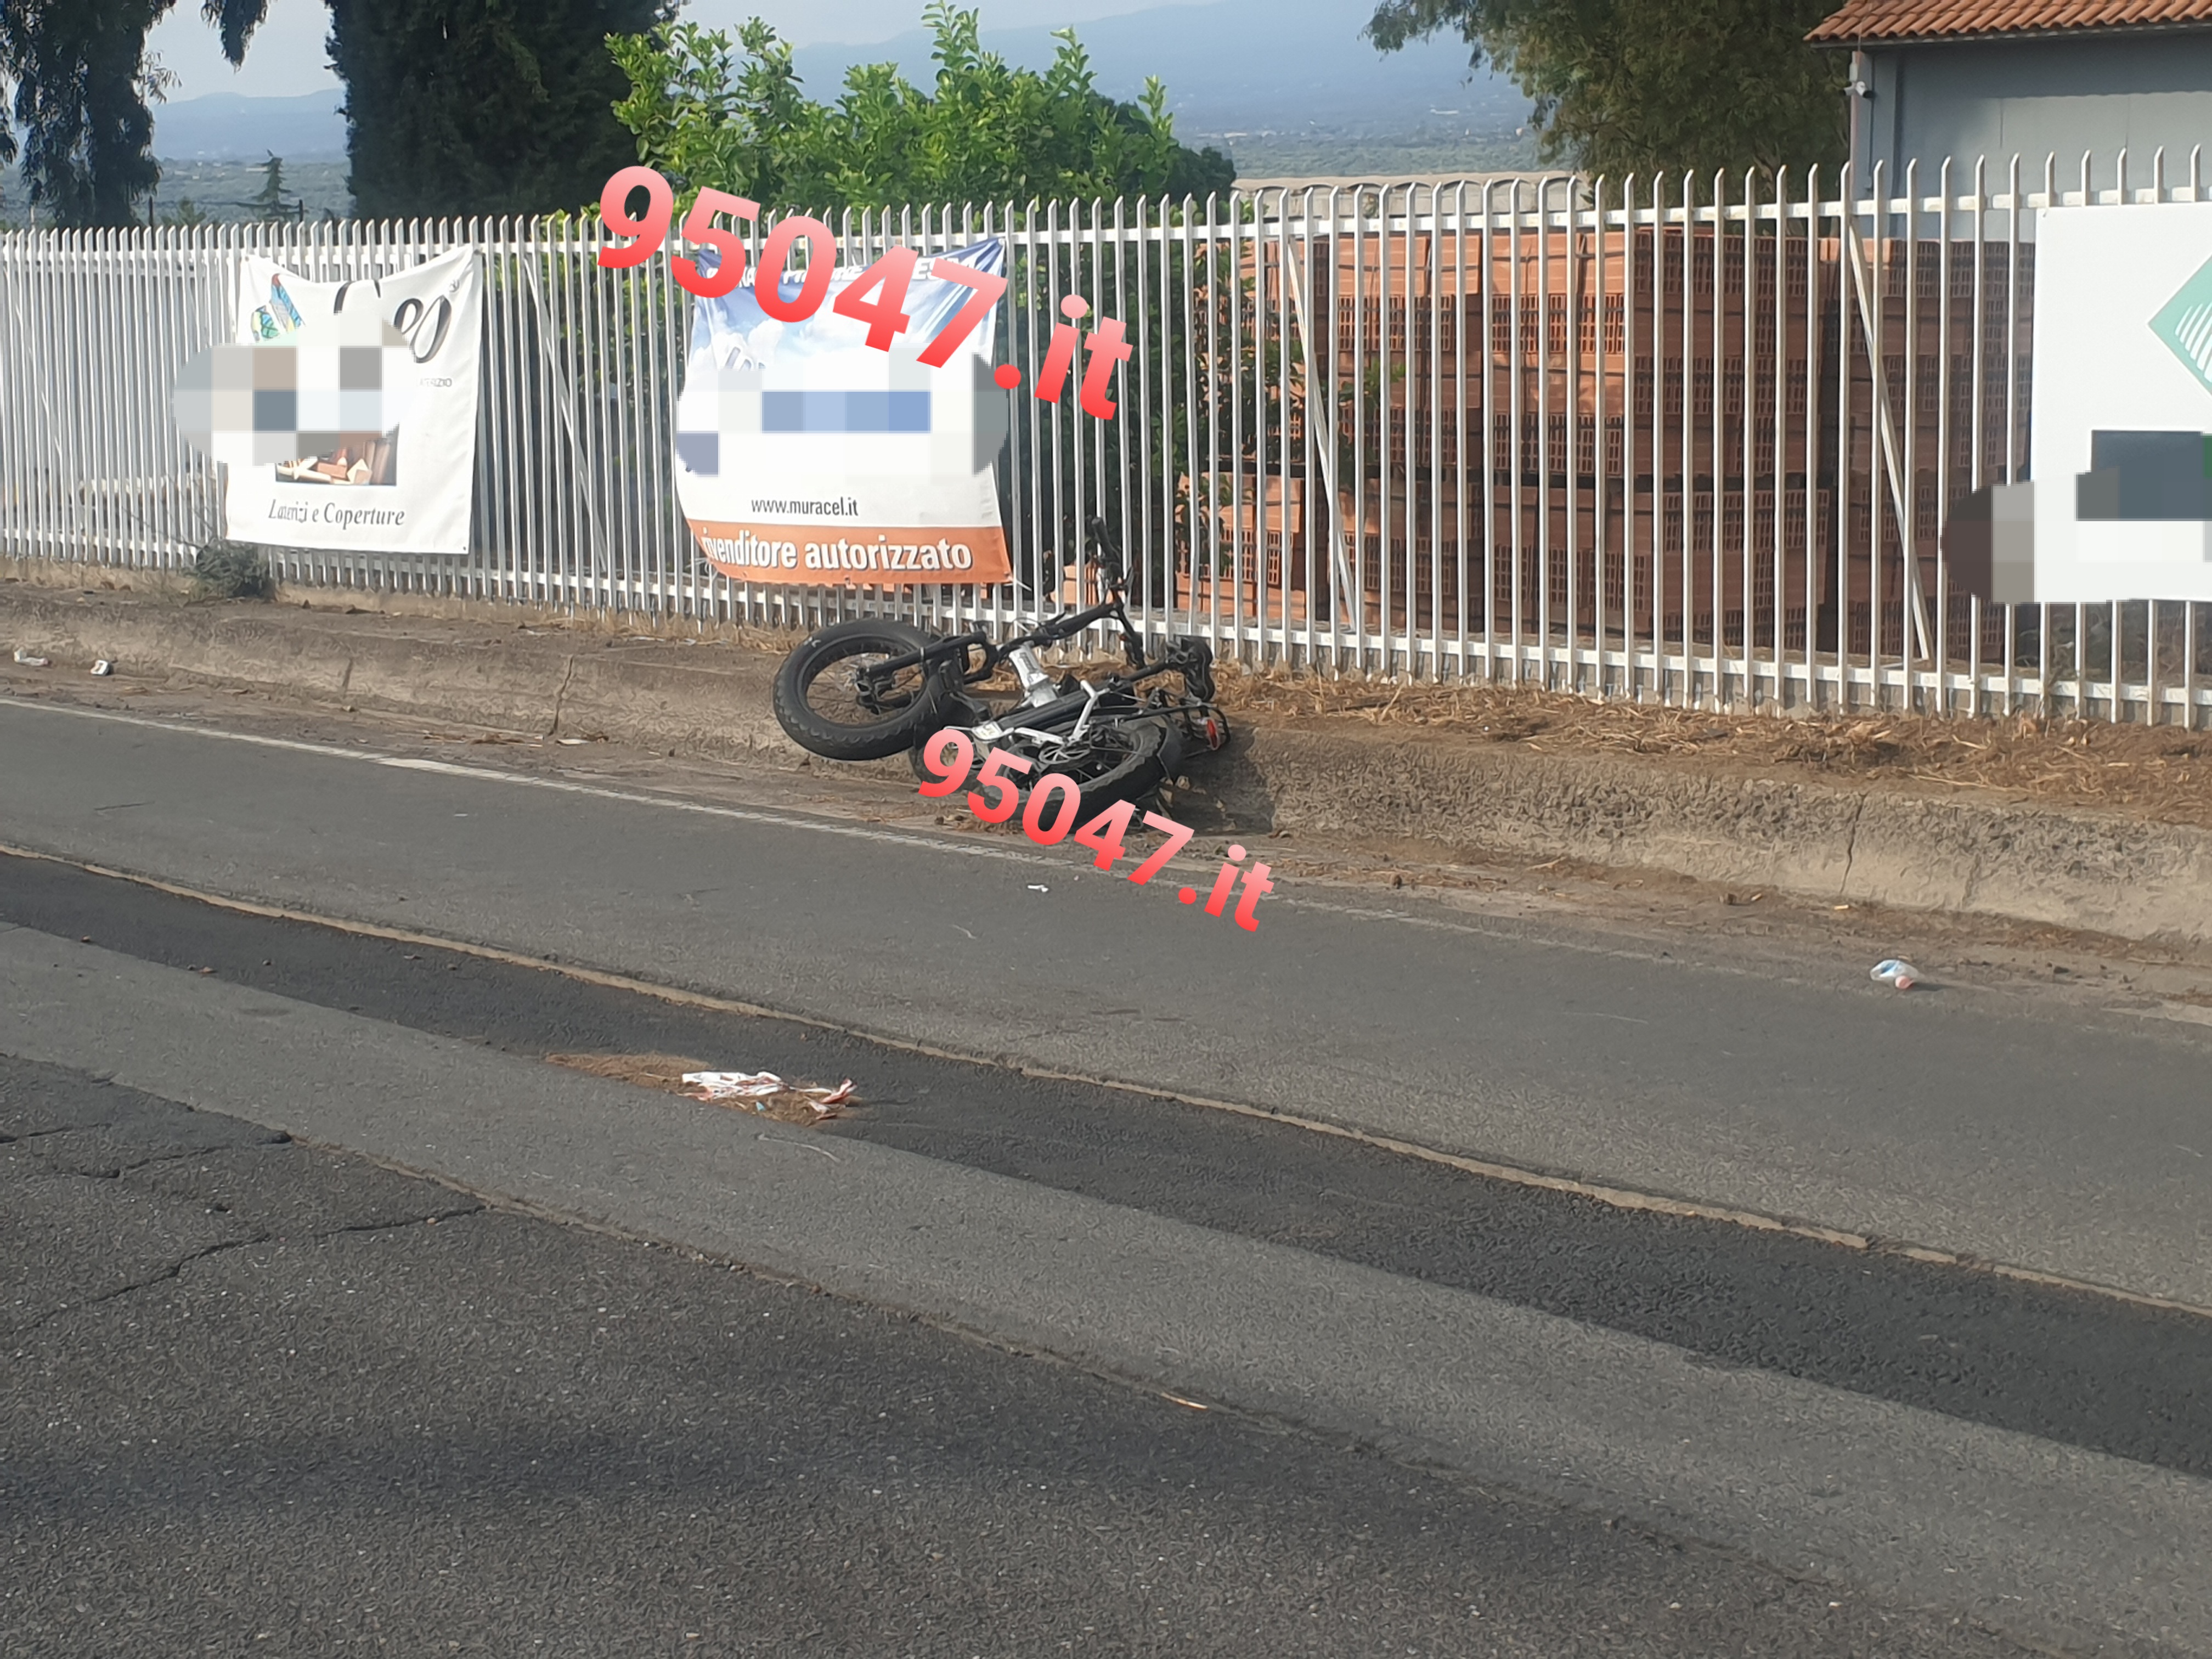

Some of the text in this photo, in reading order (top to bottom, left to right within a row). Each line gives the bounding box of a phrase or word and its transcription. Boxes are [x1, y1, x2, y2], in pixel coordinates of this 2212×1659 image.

[312, 508, 319, 523] e
[324, 502, 405, 530] Coperture
[751, 496, 859, 516] www.muracel.it
[804, 534, 973, 570] autorizzato
